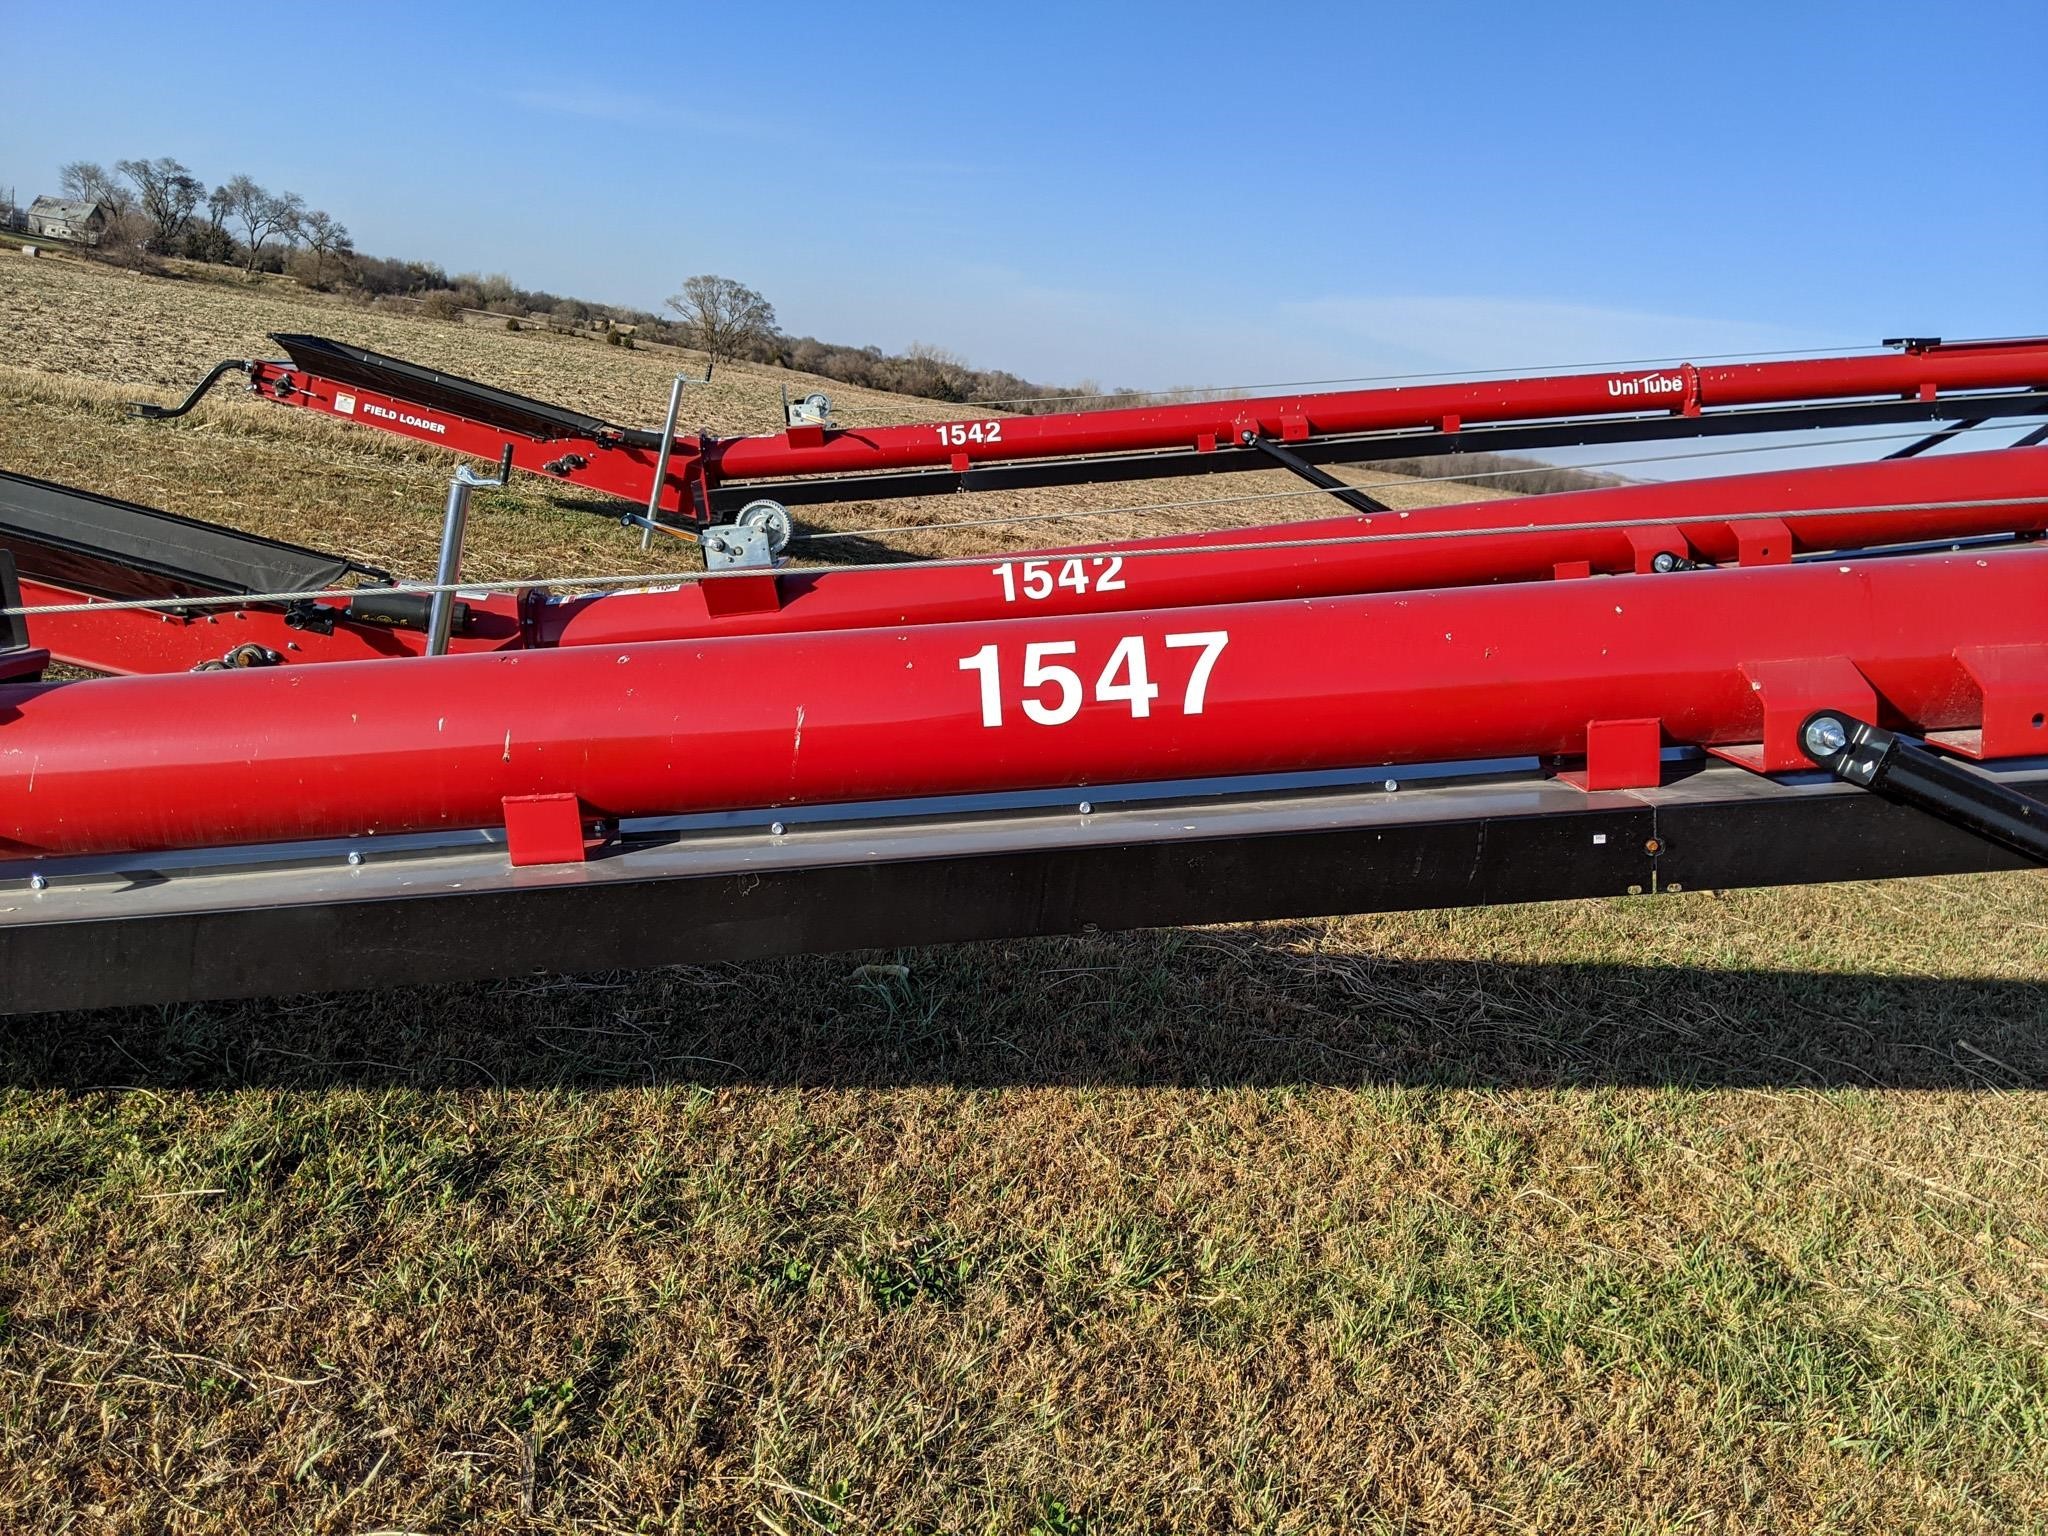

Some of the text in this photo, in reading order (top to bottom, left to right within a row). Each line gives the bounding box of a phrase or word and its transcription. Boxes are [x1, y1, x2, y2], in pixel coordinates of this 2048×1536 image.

[363, 403, 397, 420] FIELD
[399, 413, 446, 434] LOADER
[936, 422, 1002, 446] 1542
[992, 556, 1126, 602] 1542
[958, 630, 1229, 728] 1547
